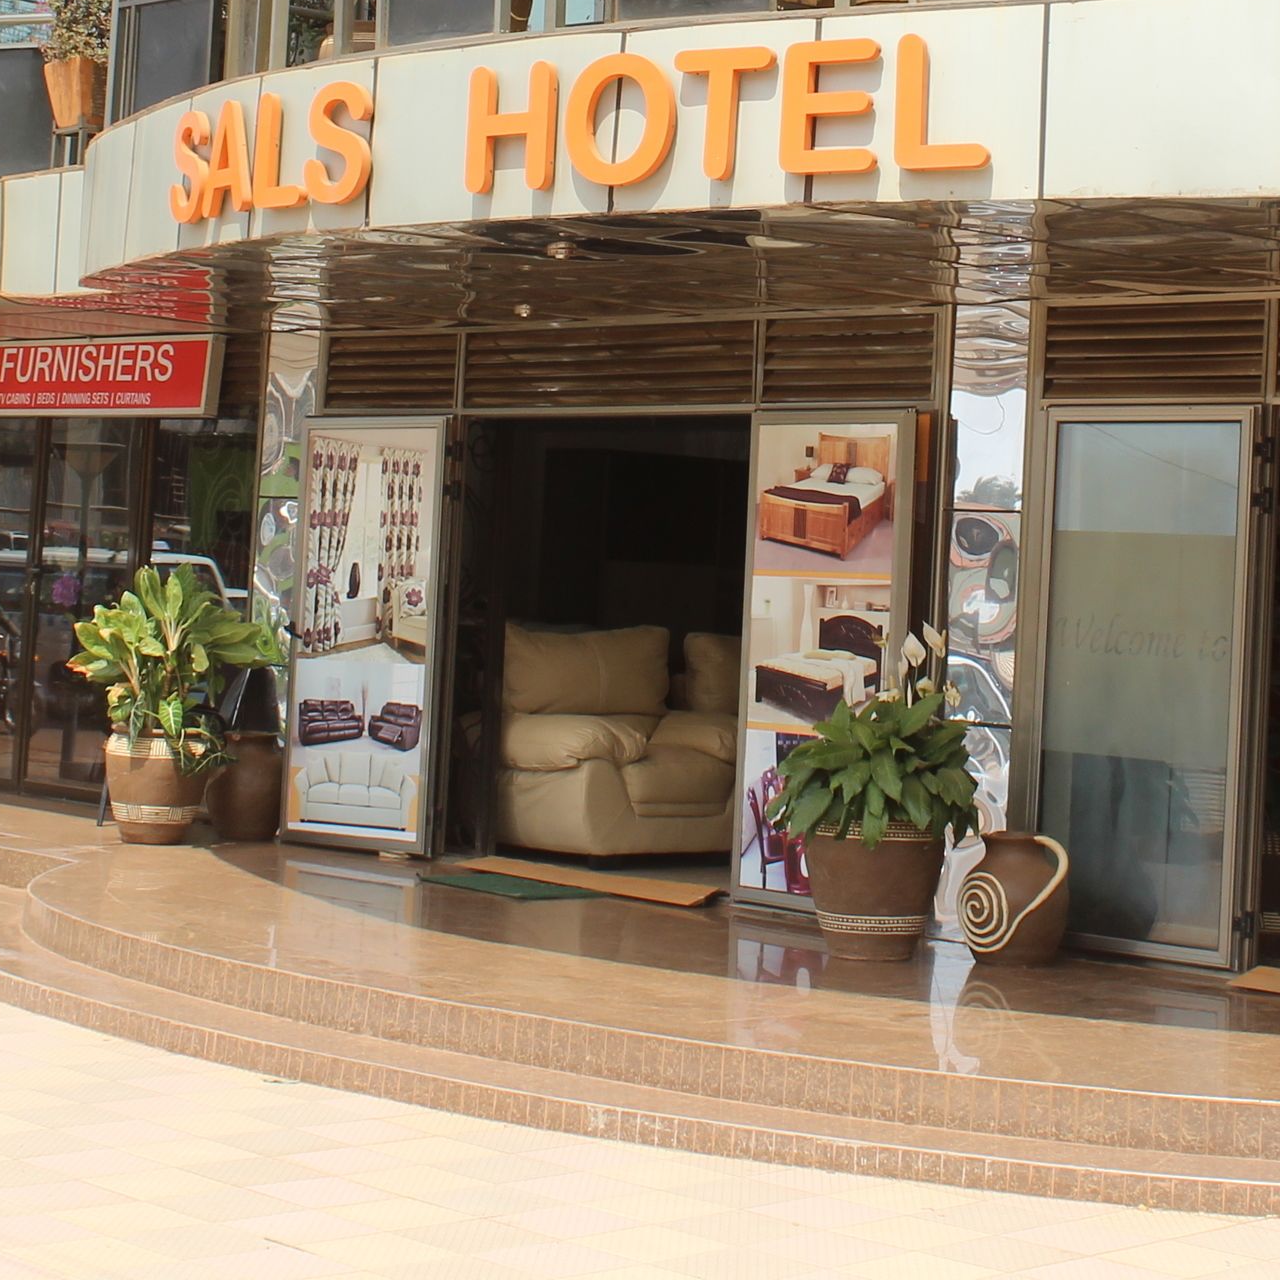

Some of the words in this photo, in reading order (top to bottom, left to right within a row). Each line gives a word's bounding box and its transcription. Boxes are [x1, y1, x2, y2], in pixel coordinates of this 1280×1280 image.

[169, 79, 375, 226] SALS
[464, 32, 992, 195] HOTEL
[0, 343, 175, 383] FURNISHERS
[36, 392, 55, 404] BEDS
[91, 392, 110, 404] SETS
[115, 392, 151, 405] CURTAINS
[1056, 612, 1186, 660] Welcome
